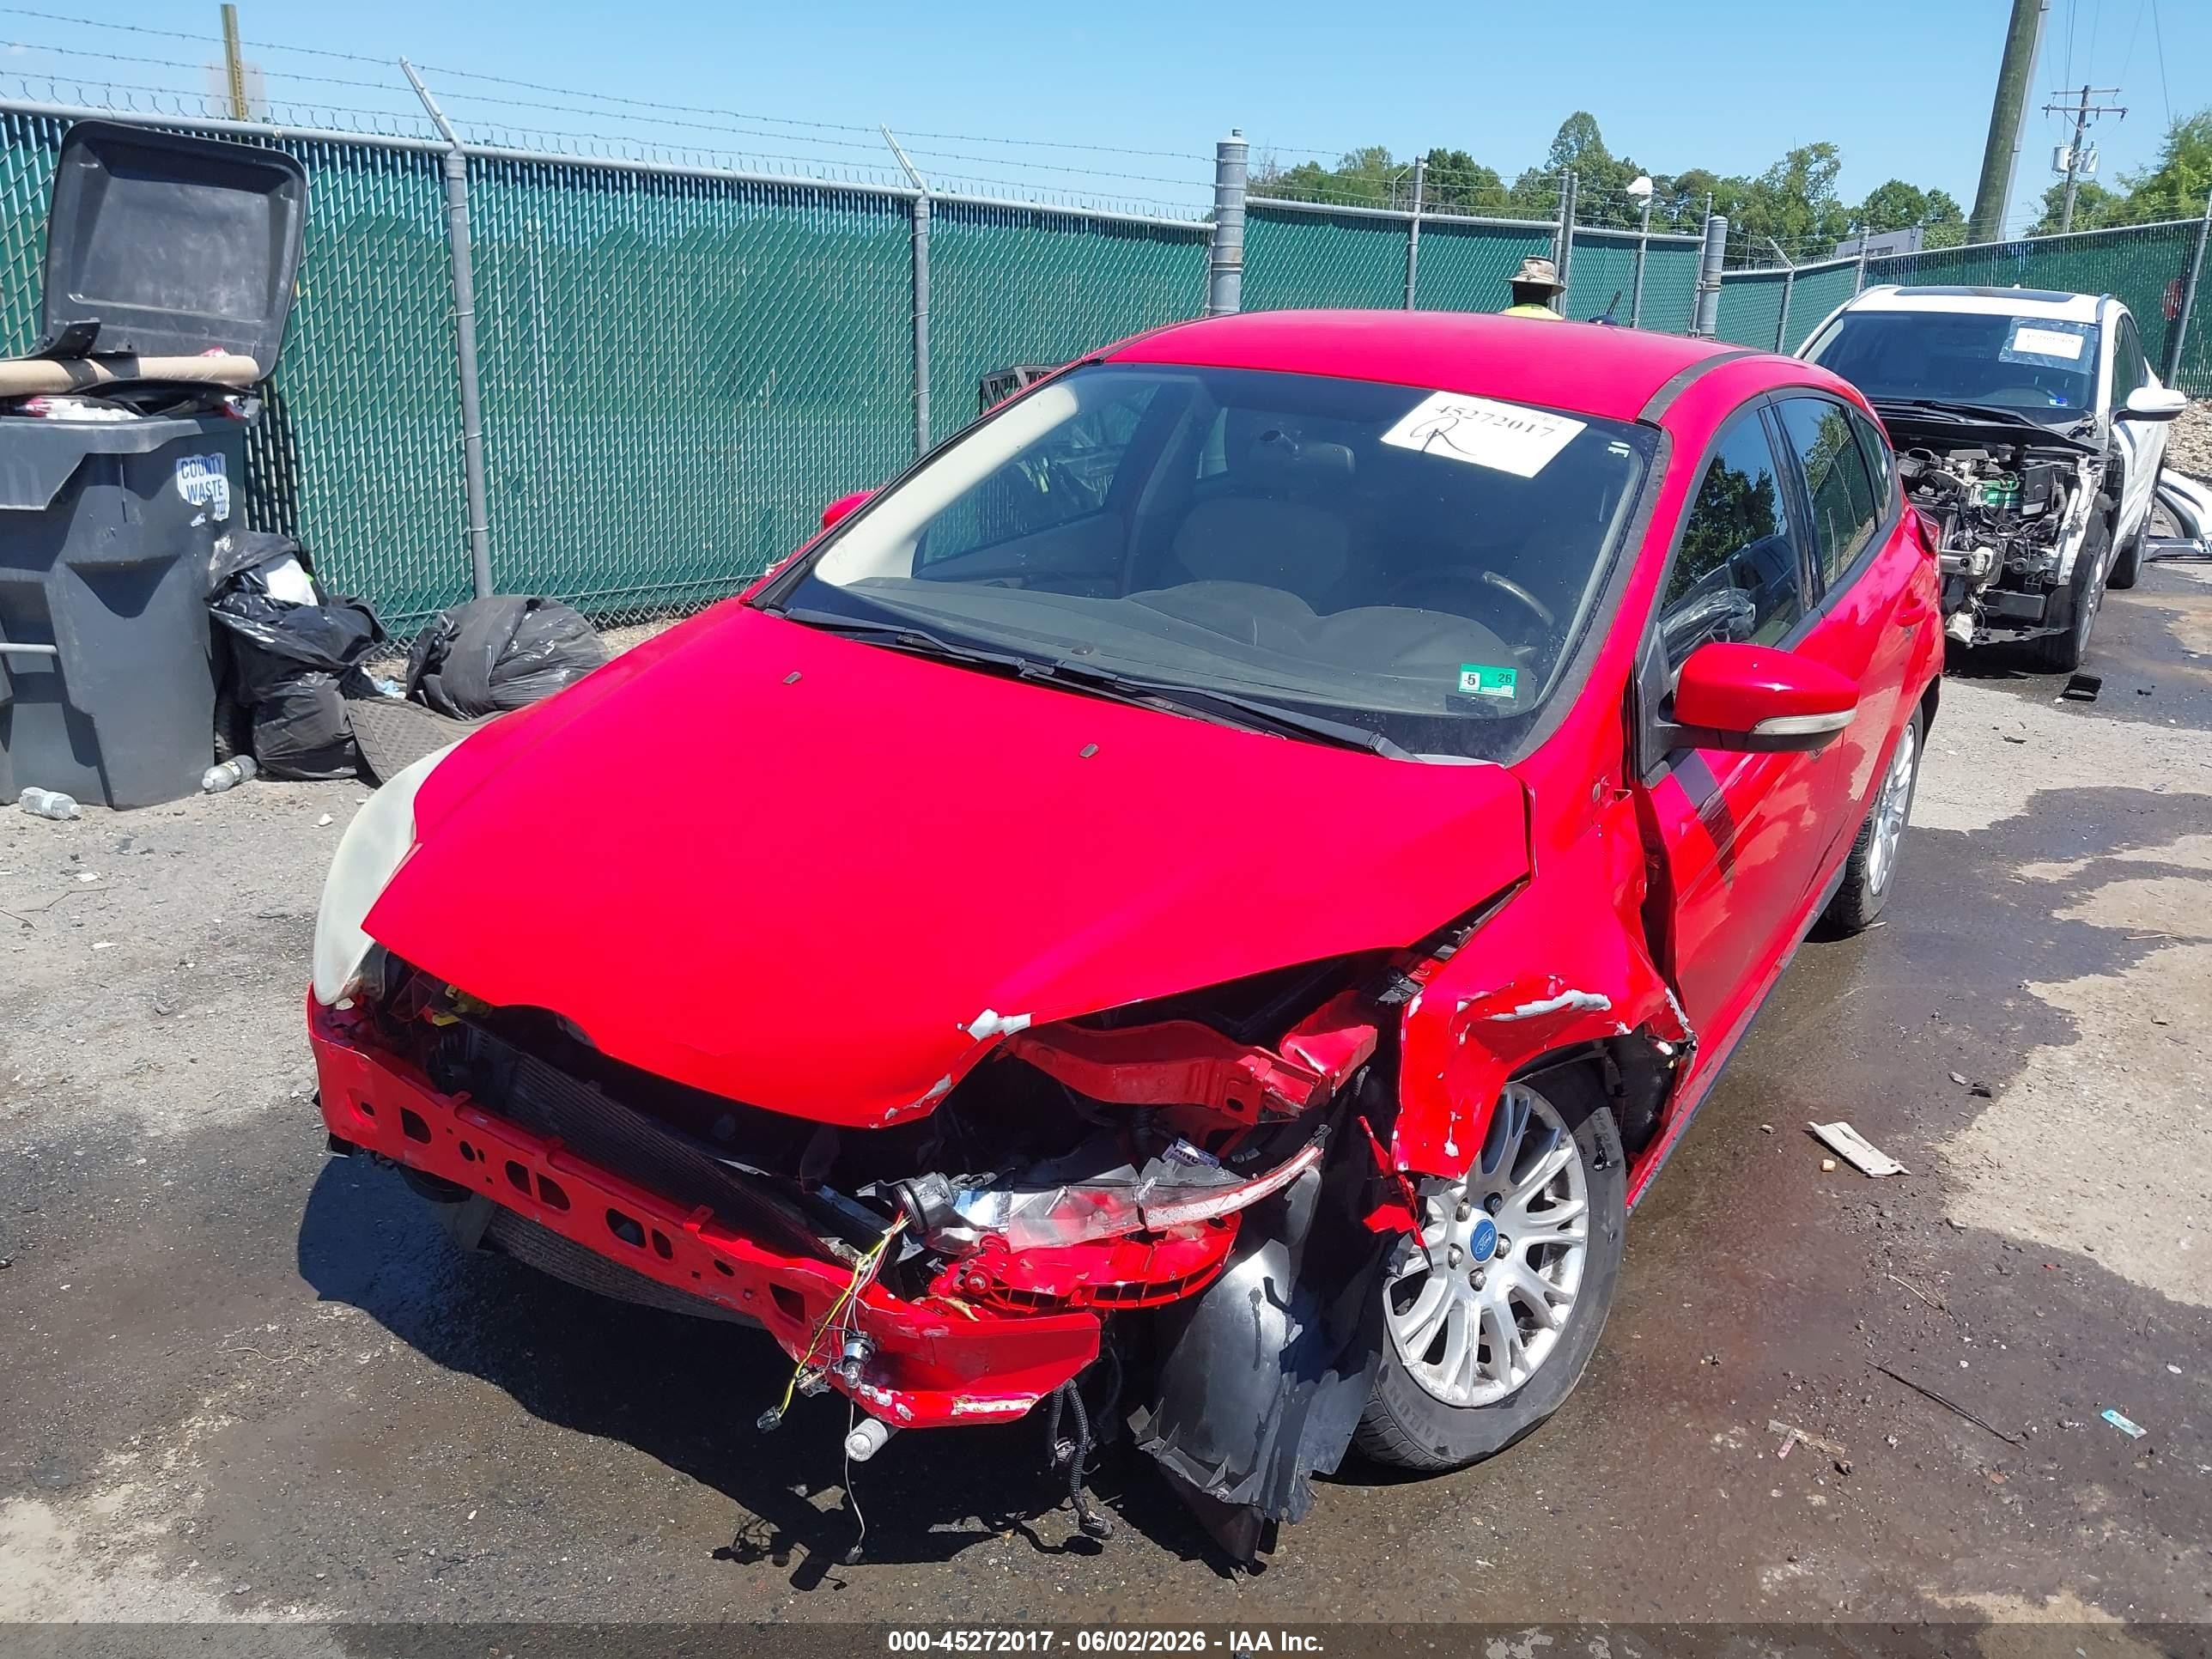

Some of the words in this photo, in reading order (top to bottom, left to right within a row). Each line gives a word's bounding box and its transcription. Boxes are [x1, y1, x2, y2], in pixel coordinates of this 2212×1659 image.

[1435, 404, 1556, 438] 45272017
[180, 455, 222, 479] COUNTY
[186, 479, 223, 502] WASTE
[1498, 672, 1512, 684] 26
